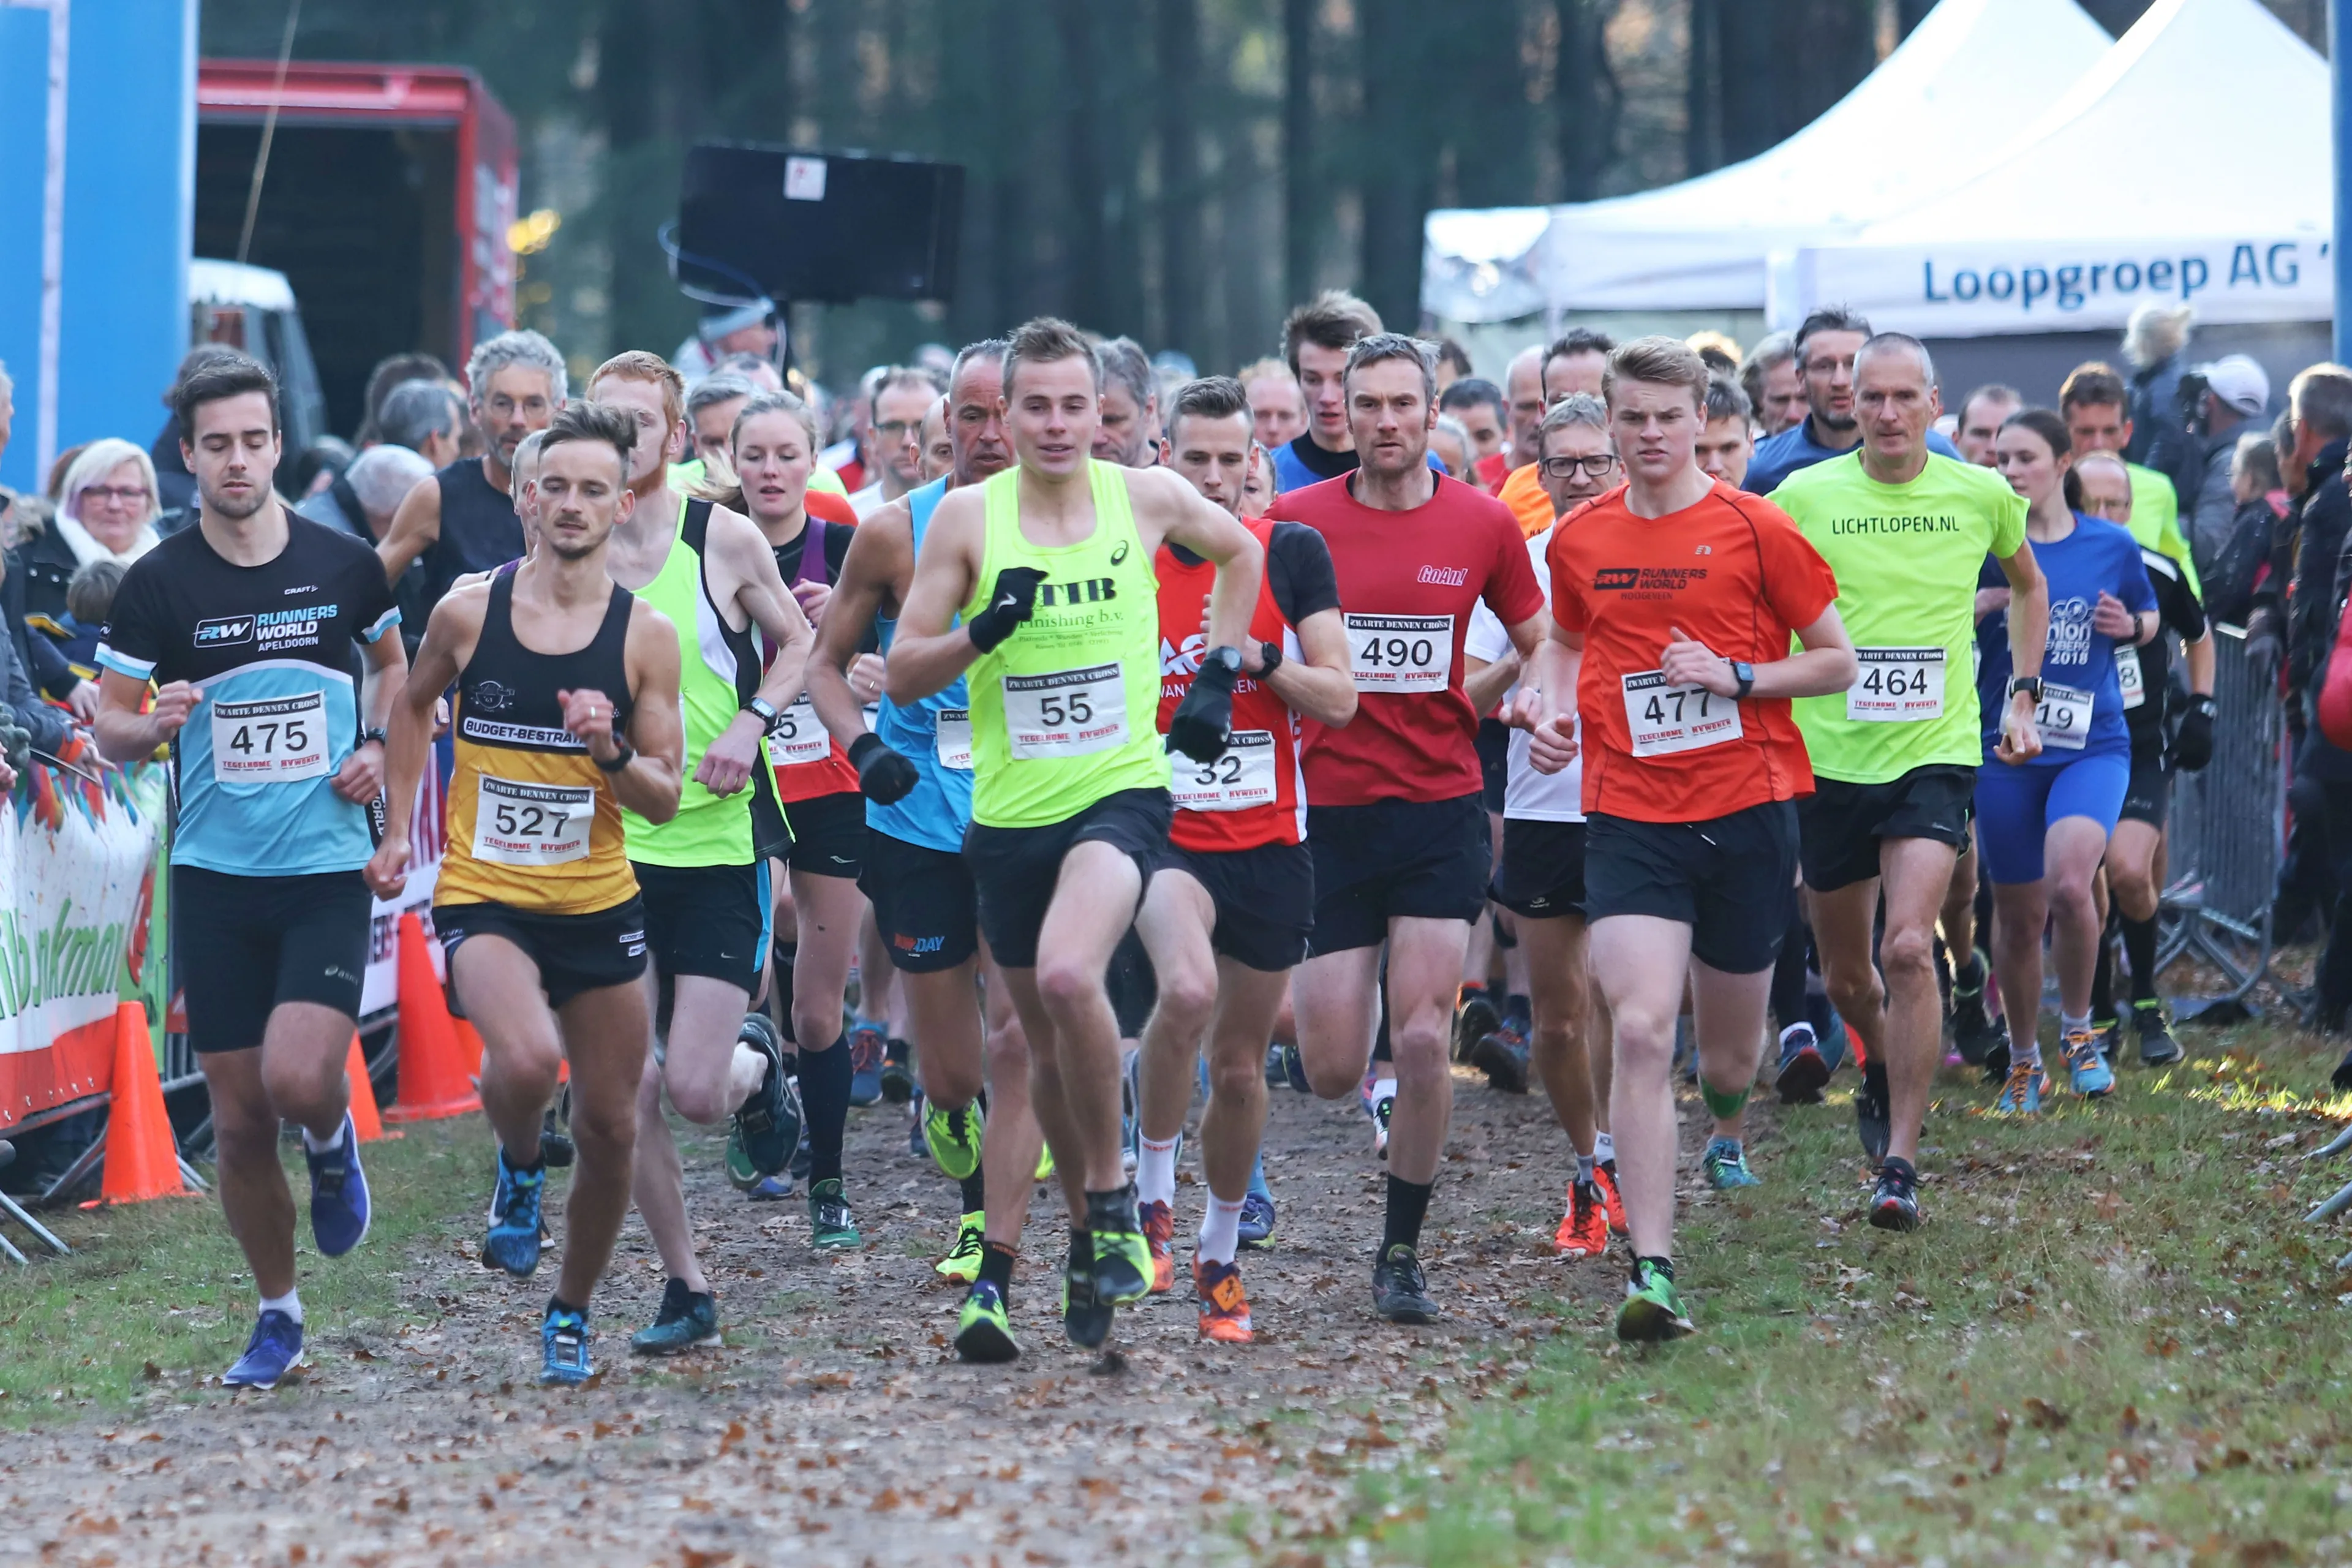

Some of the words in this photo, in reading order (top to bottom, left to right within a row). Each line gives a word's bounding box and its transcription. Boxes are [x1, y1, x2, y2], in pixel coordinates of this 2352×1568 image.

[1923, 256, 2209, 311] Loopgroep
[2229, 243, 2299, 288] AG
[1832, 515, 1960, 535] LICHTLOPEN.NL
[1640, 568, 1708, 579] RUNNERS
[284, 586, 311, 595] CRAFT
[1640, 579, 1688, 590] WORLD
[257, 605, 337, 627] RUNNERS
[1349, 619, 1384, 628] ZWARTE
[1386, 620, 1422, 629] DENNEN
[1422, 620, 1449, 629] CROSS
[256, 621, 318, 641] WORLD
[258, 636, 318, 652] APELDOORN
[1361, 638, 1433, 667] 490
[2050, 651, 2089, 665] 2018
[1008, 679, 1046, 688] ZWARTE
[1047, 673, 1087, 686] DENNEN
[1087, 666, 1118, 680] CROSS
[1626, 677, 1659, 688] ZWARTE
[1863, 668, 1928, 695] 464
[252, 703, 290, 715] DENNEN
[292, 698, 320, 710] CROSS
[1041, 692, 1093, 727] 55
[1645, 687, 1711, 725] 477
[230, 720, 308, 755] 475
[1242, 736, 1271, 745] CROSS
[484, 781, 518, 796] ZWARTE
[520, 789, 557, 800] DENNEN
[560, 793, 588, 801] CROSS
[496, 804, 570, 838] 527
